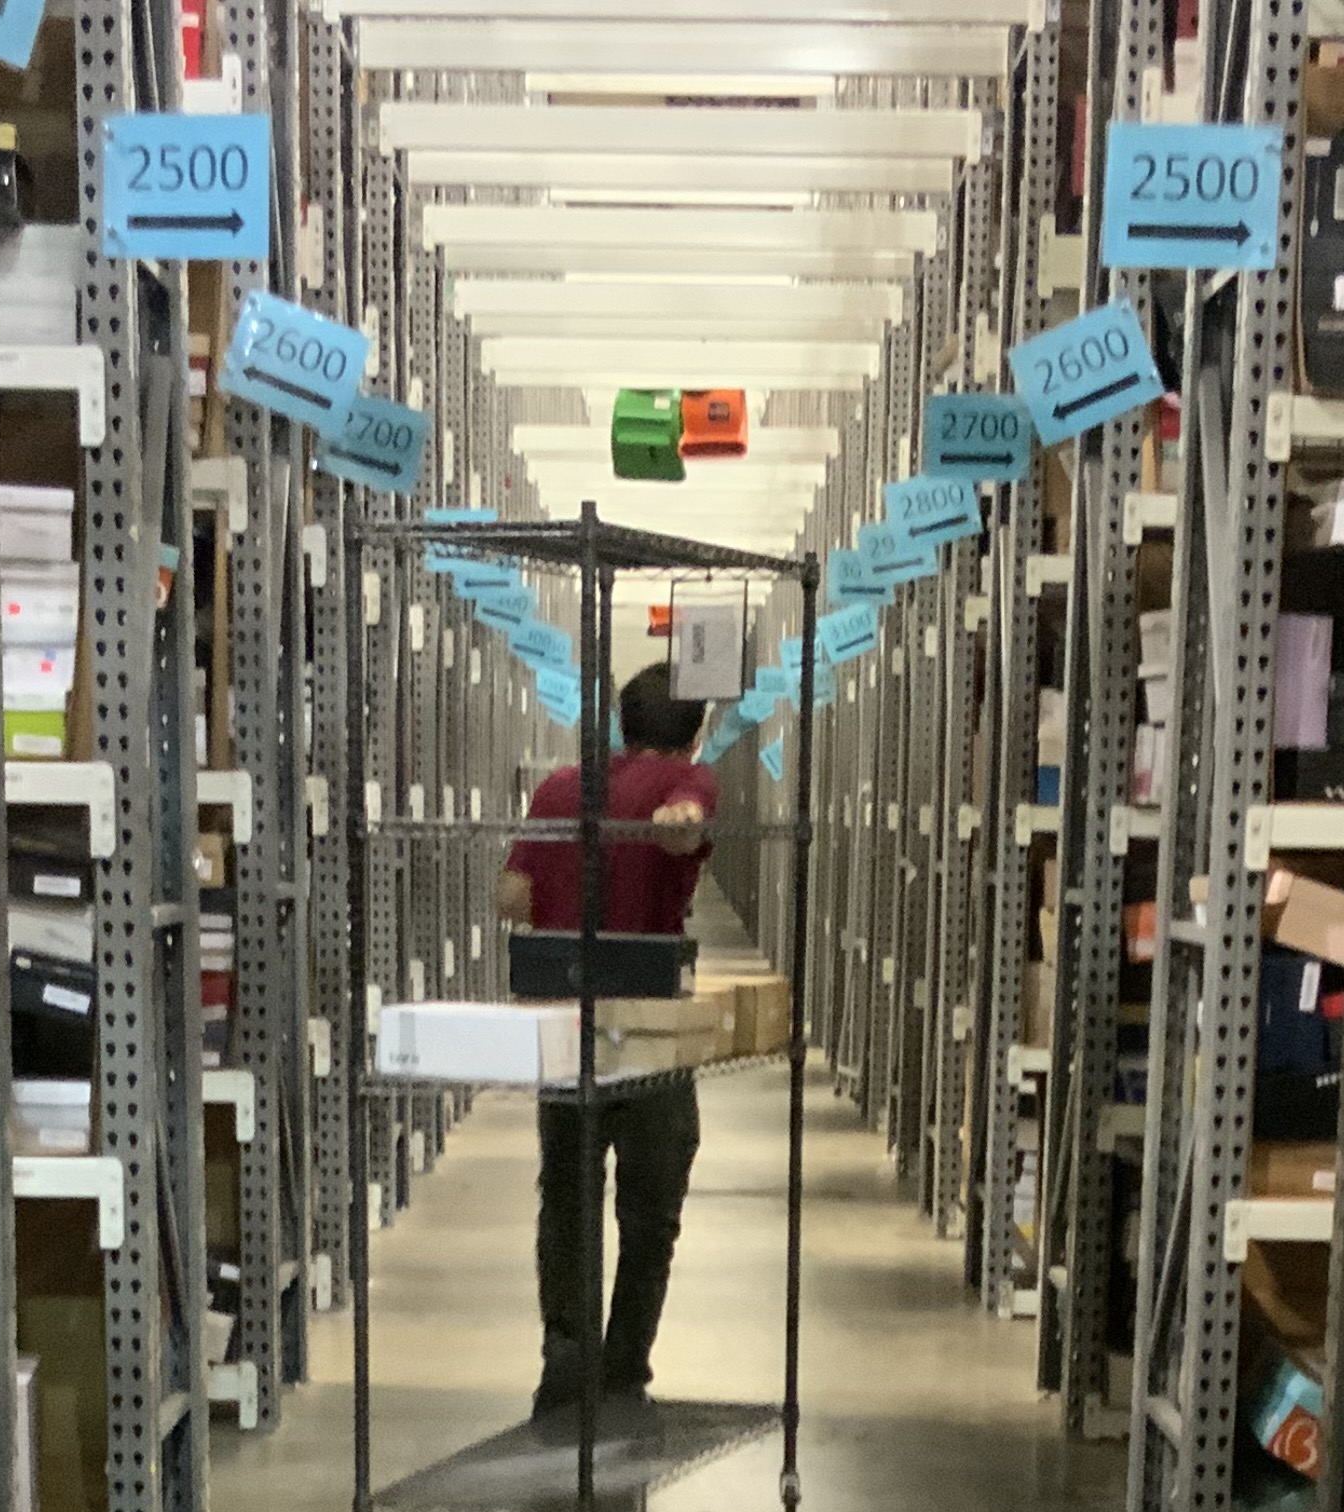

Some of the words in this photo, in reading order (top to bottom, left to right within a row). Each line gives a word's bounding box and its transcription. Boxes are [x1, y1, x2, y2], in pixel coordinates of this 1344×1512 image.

[126, 144, 249, 193] 2500
[1130, 153, 1260, 203] 2500
[251, 316, 348, 383] 2600
[1034, 327, 1131, 396] 2600
[940, 410, 1019, 443] 2700
[902, 484, 965, 520] 2800
[867, 534, 896, 559] 29
